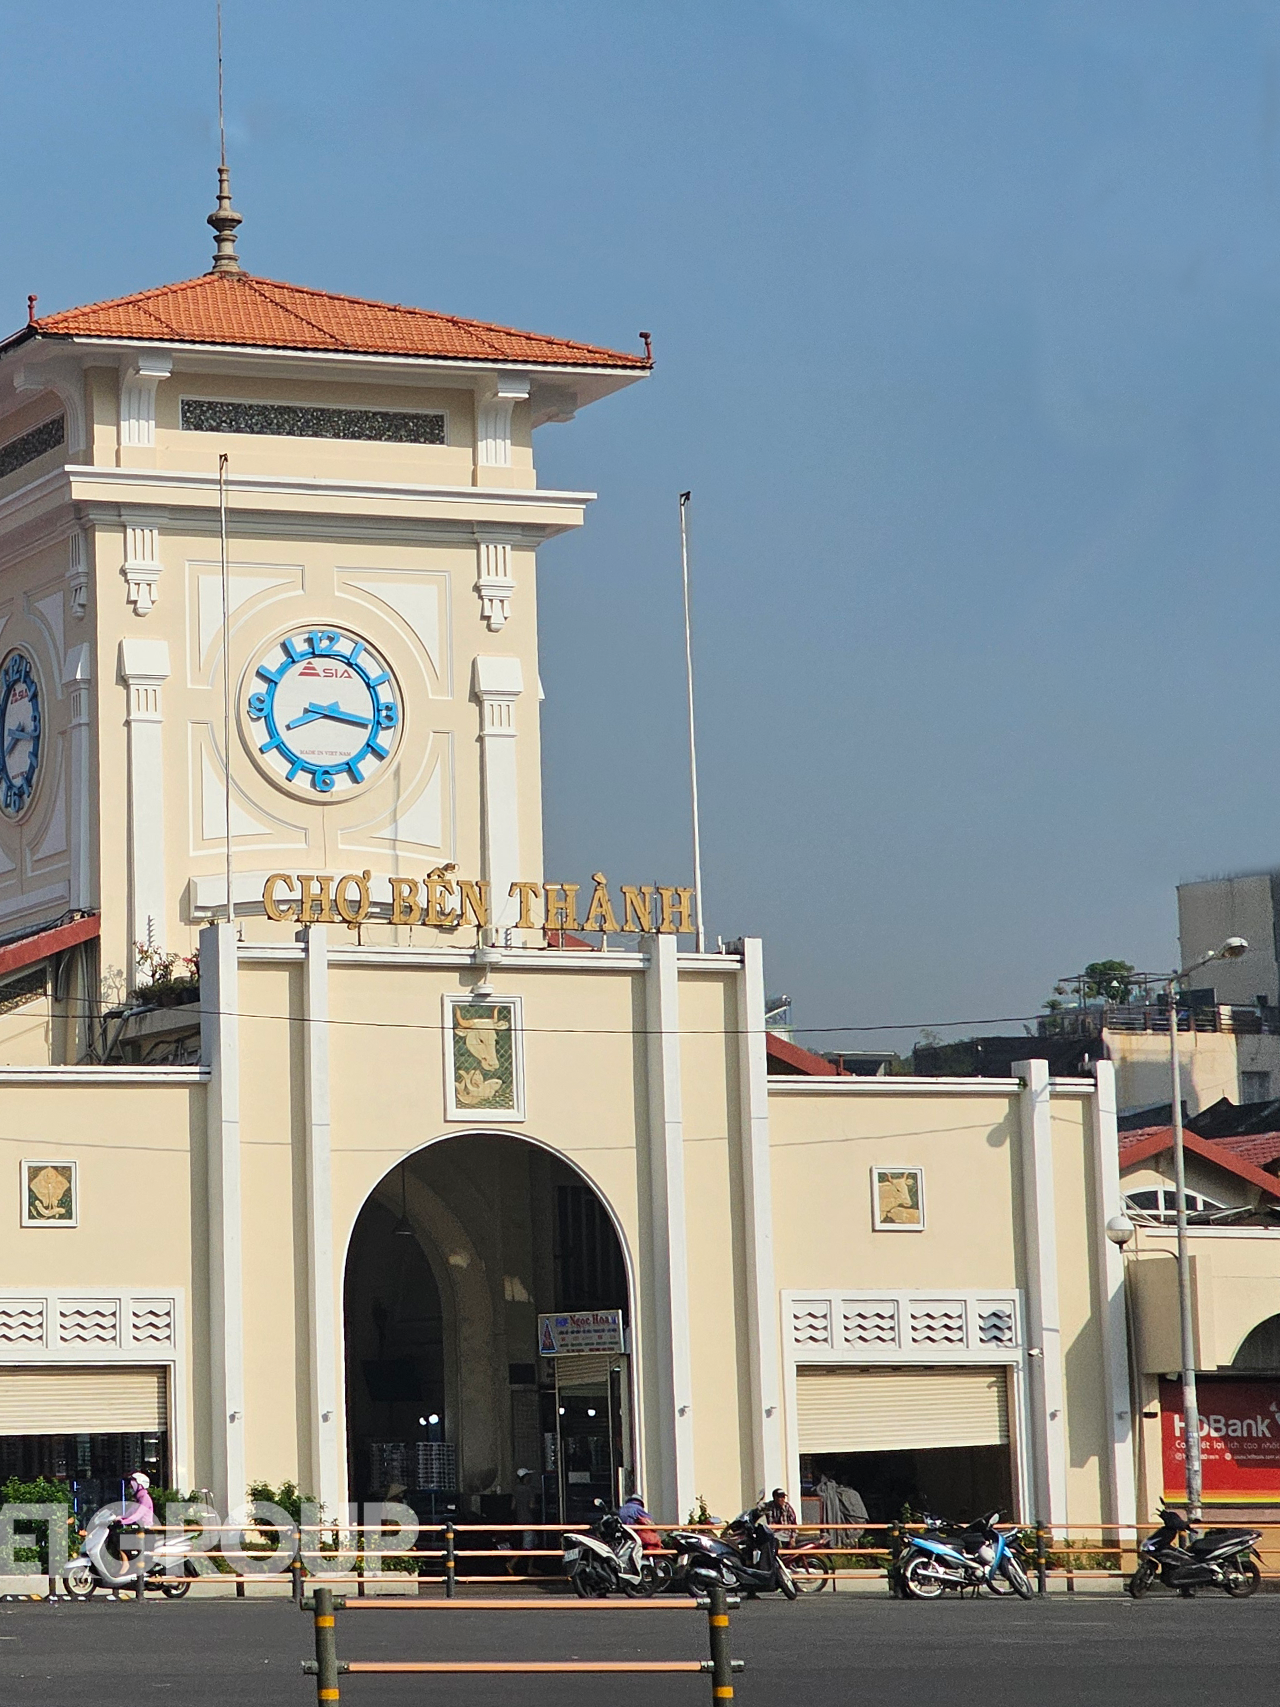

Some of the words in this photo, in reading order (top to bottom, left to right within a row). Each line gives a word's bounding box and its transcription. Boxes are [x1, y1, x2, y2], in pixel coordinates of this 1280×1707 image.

[308, 630, 342, 655] 12
[297, 660, 354, 680] ASIA
[249, 692, 272, 718] 9
[378, 701, 400, 728] 3
[314, 766, 335, 792] 6
[262, 868, 372, 930] CHỢ
[389, 863, 491, 927] BẾN
[509, 871, 696, 933] THÀNH
